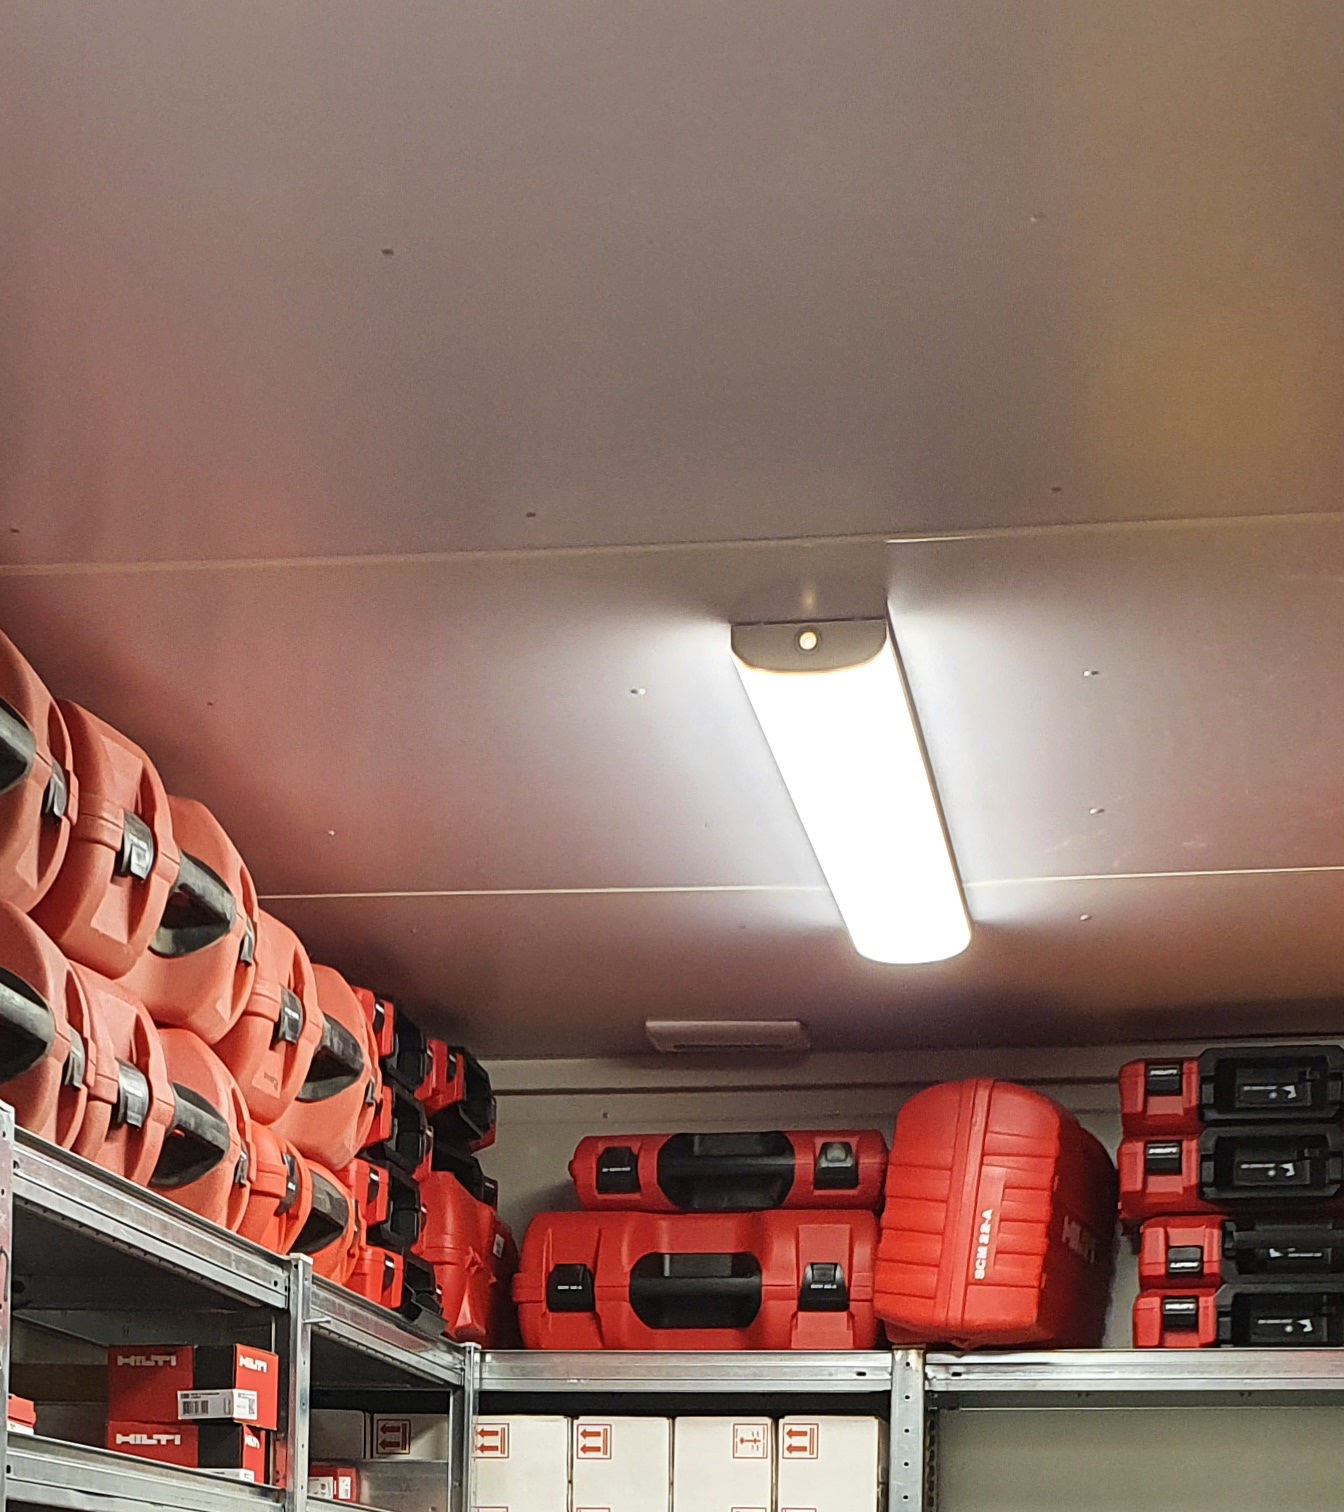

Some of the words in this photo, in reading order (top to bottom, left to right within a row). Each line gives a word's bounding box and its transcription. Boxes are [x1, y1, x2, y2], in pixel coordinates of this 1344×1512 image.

[978, 1209, 993, 1245] 22-A
[974, 1246, 988, 1280] SCM
[117, 1355, 176, 1366] HILTI
[239, 1355, 267, 1373] HILTI
[116, 1434, 181, 1445] HILTI
